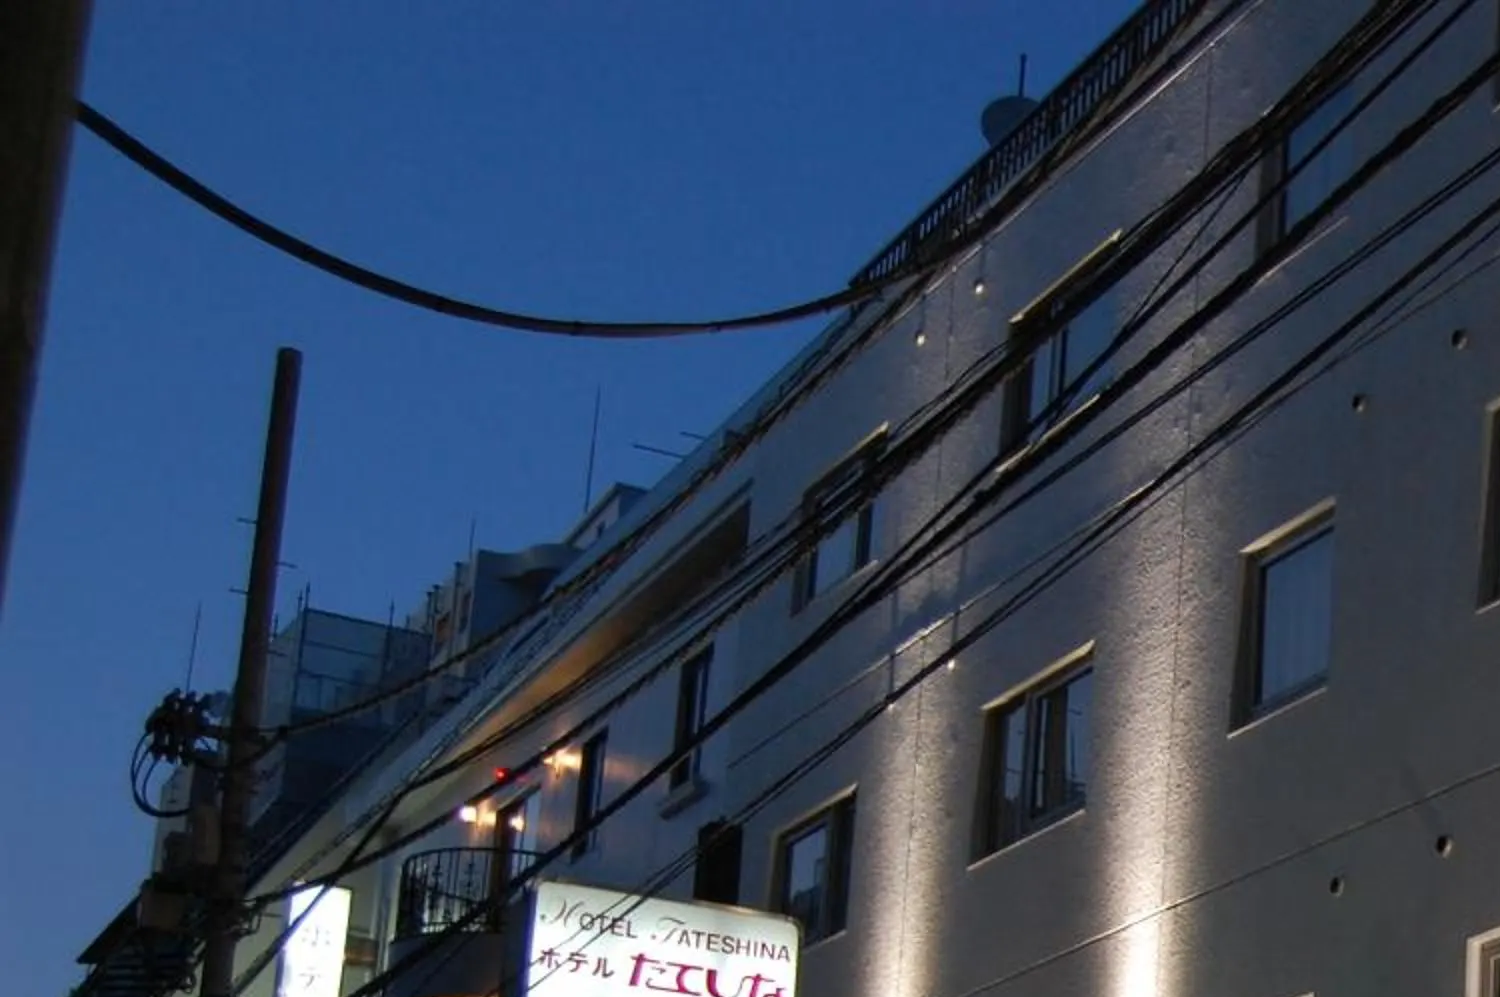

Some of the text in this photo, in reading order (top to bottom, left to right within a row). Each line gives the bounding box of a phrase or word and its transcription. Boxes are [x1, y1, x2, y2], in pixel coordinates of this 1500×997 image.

[540, 899, 791, 962] HOTEL TATESHINA
[539, 948, 615, 978] ホテル
